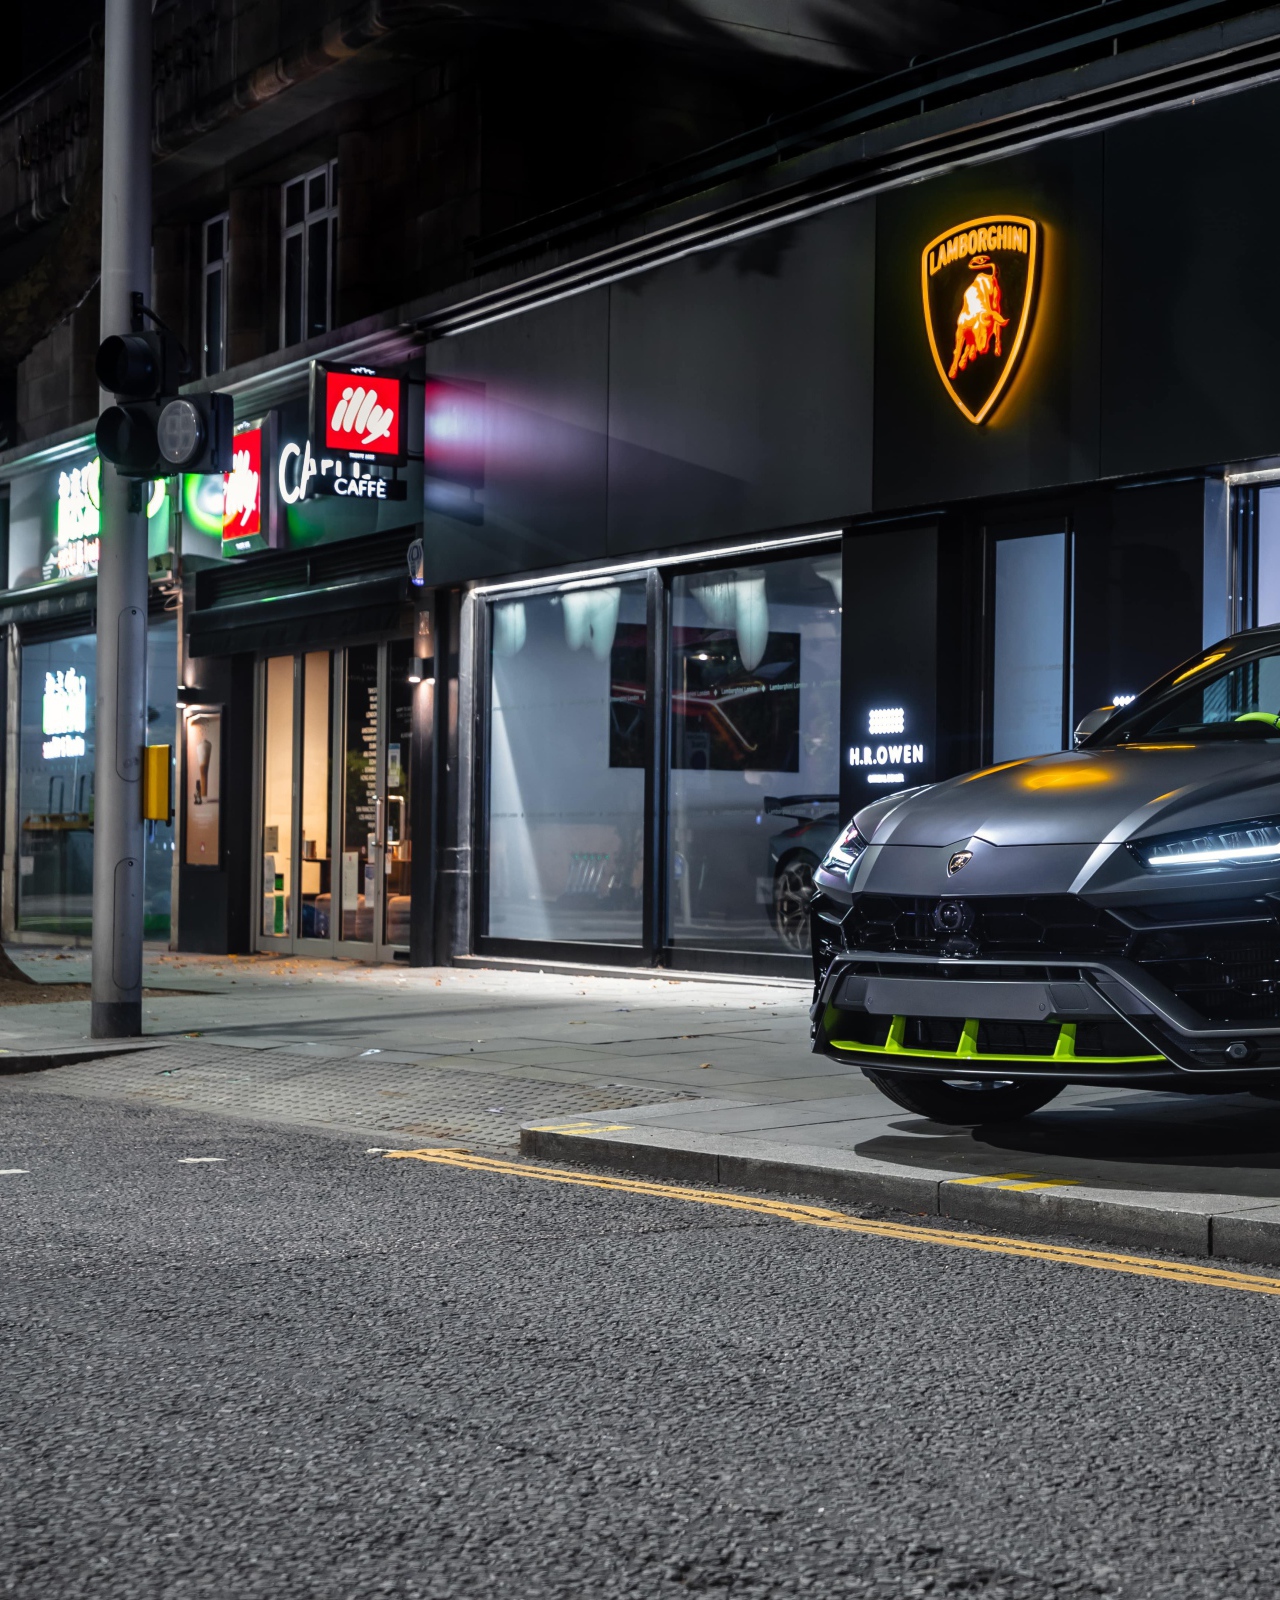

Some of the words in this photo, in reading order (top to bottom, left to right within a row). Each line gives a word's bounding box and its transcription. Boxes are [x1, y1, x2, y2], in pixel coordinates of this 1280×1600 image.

[929, 225, 1028, 277] LAMBORGHINI
[331, 386, 394, 445] illy
[334, 477, 387, 499] CAFFÈ
